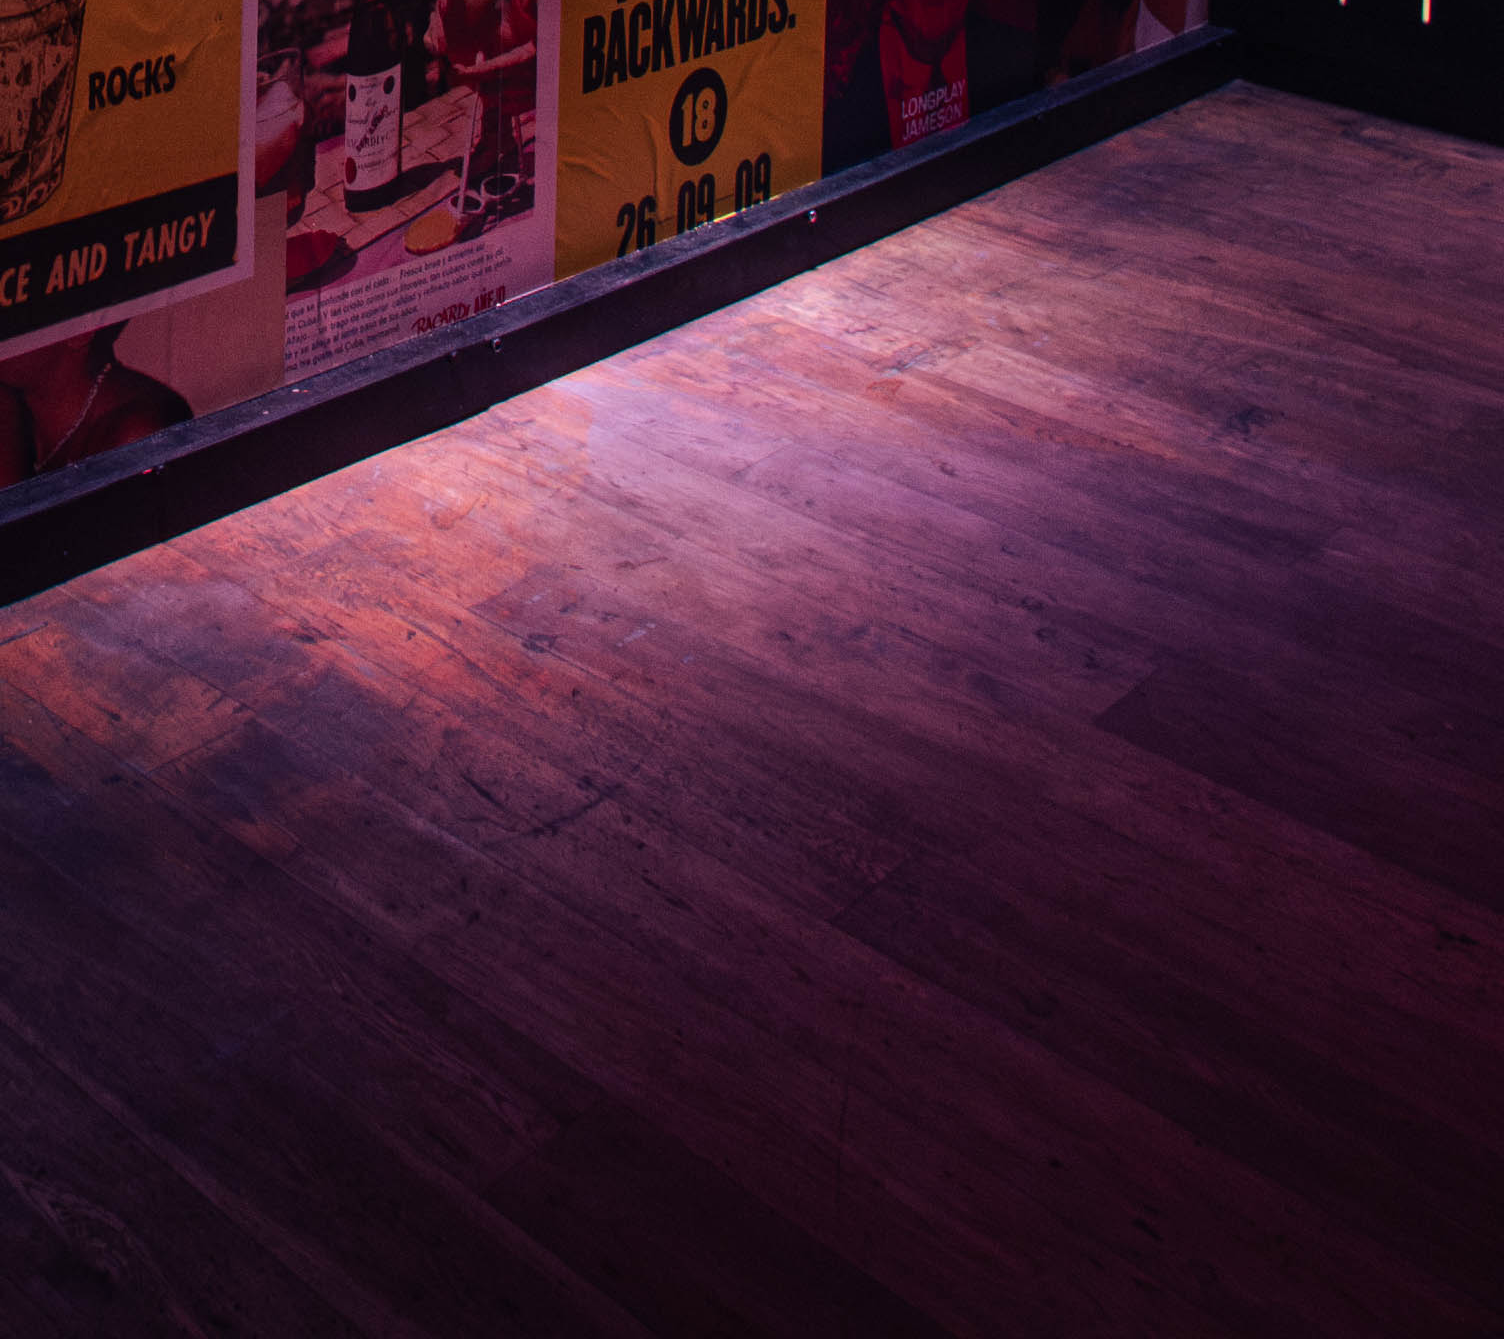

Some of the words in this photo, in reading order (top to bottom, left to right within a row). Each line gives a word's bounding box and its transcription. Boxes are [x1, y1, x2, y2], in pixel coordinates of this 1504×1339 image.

[88, 53, 177, 111] ROCKS
[899, 78, 967, 120] LONGPLAY
[680, 86, 718, 149] 18
[45, 241, 108, 298] AND
[122, 208, 217, 267] TANGY
